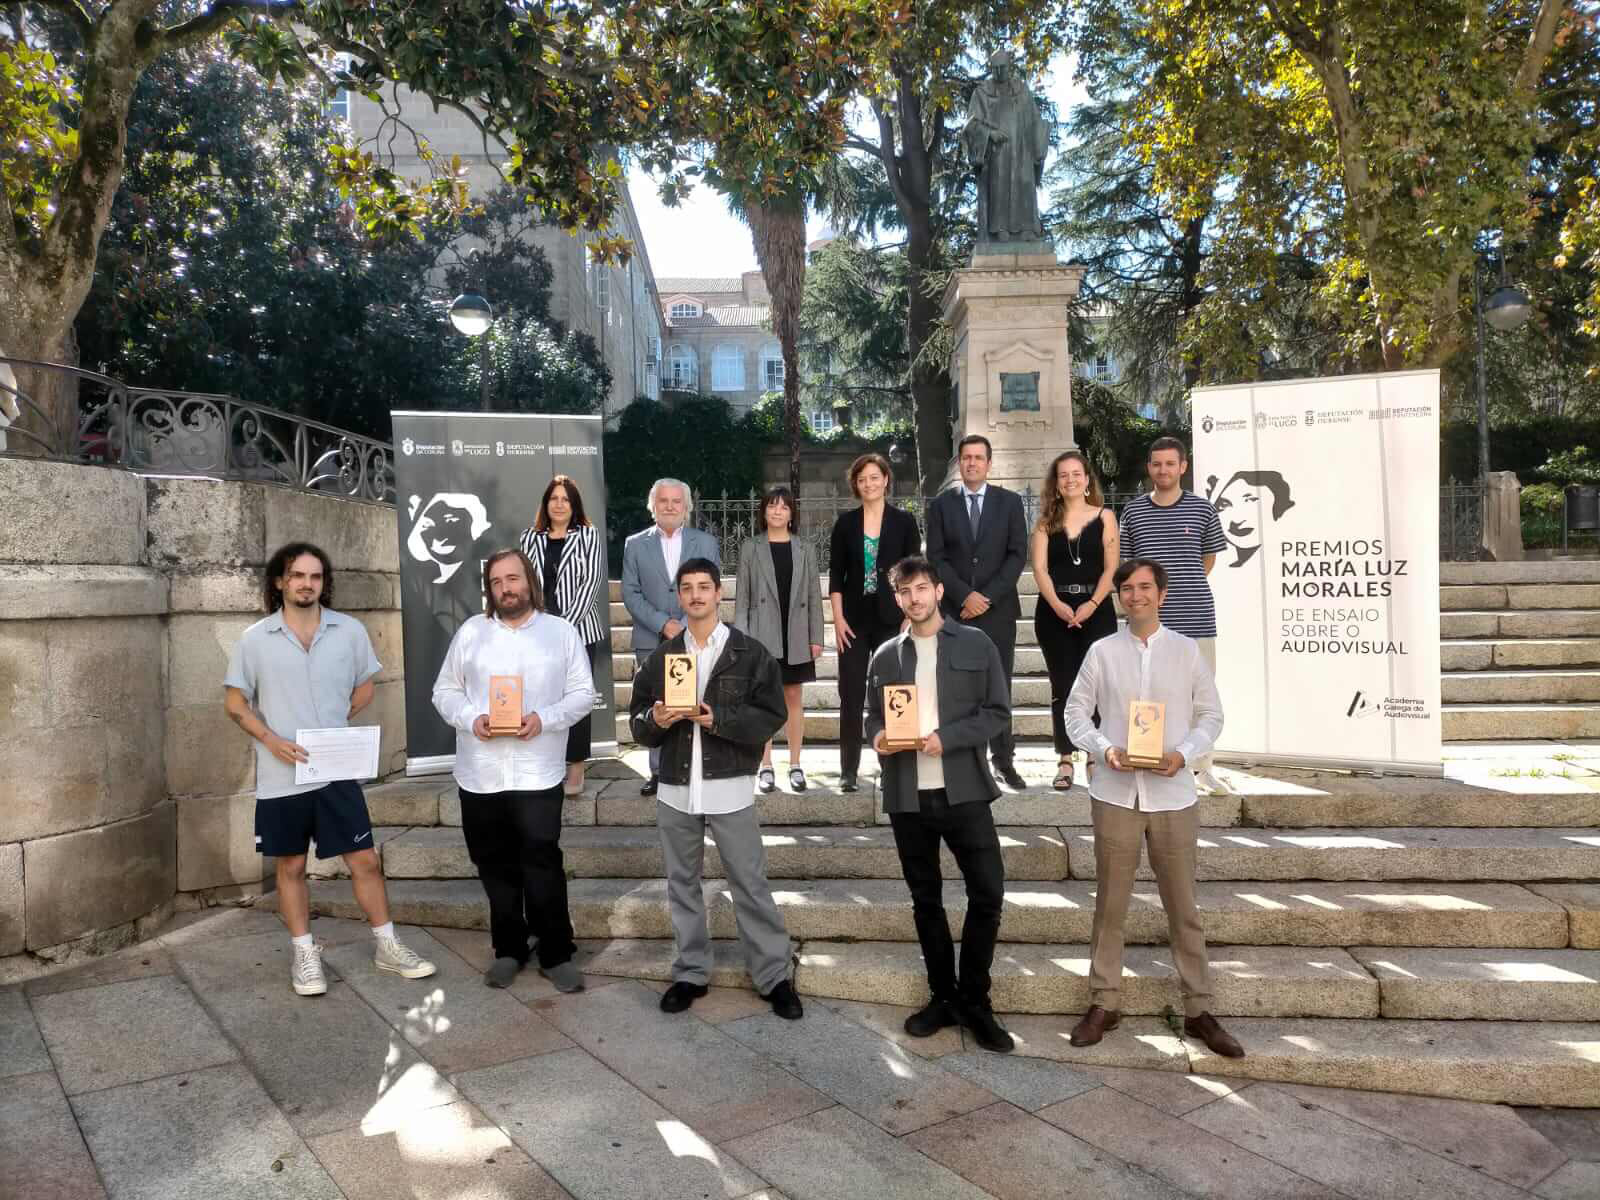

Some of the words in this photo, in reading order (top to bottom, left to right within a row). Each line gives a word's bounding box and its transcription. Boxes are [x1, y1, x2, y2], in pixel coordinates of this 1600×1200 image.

[1281, 539, 1383, 557] PREMIOS
[1281, 558, 1358, 577] MARÍA
[1364, 560, 1408, 576] LUZ
[1281, 581, 1392, 598] MORALES
[1281, 608, 1305, 621] DE
[1312, 608, 1380, 621] ENSAIO
[1281, 624, 1339, 637] SOBRE
[1346, 624, 1360, 638] O
[1281, 640, 1409, 655] AUDIOVISUAL
[1384, 711, 1431, 719] Audiovisual
